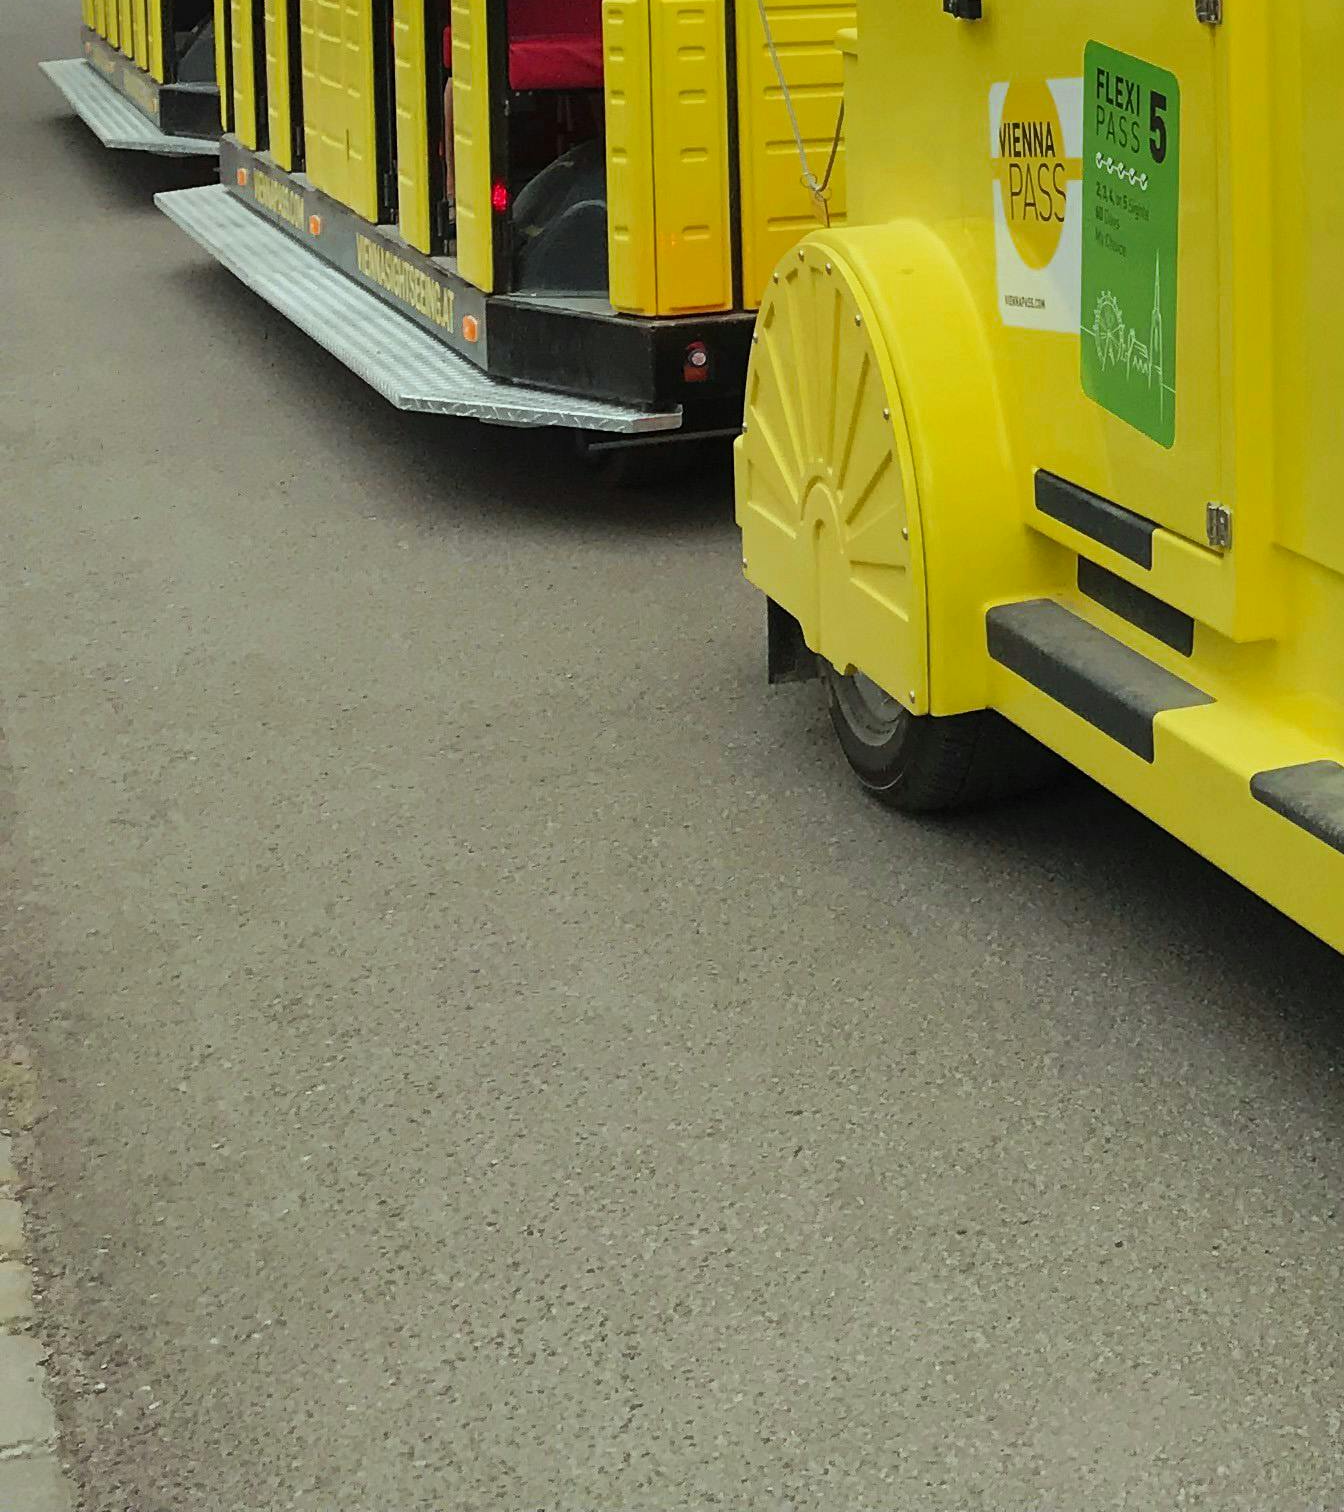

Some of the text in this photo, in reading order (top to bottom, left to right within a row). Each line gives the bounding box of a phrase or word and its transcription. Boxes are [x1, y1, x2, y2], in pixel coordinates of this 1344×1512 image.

[1097, 68, 1140, 117] FLEXI
[999, 121, 1055, 158] VIENNA
[1096, 105, 1140, 153] PASS
[1150, 90, 1167, 164] 5
[1009, 163, 1066, 223] PASS
